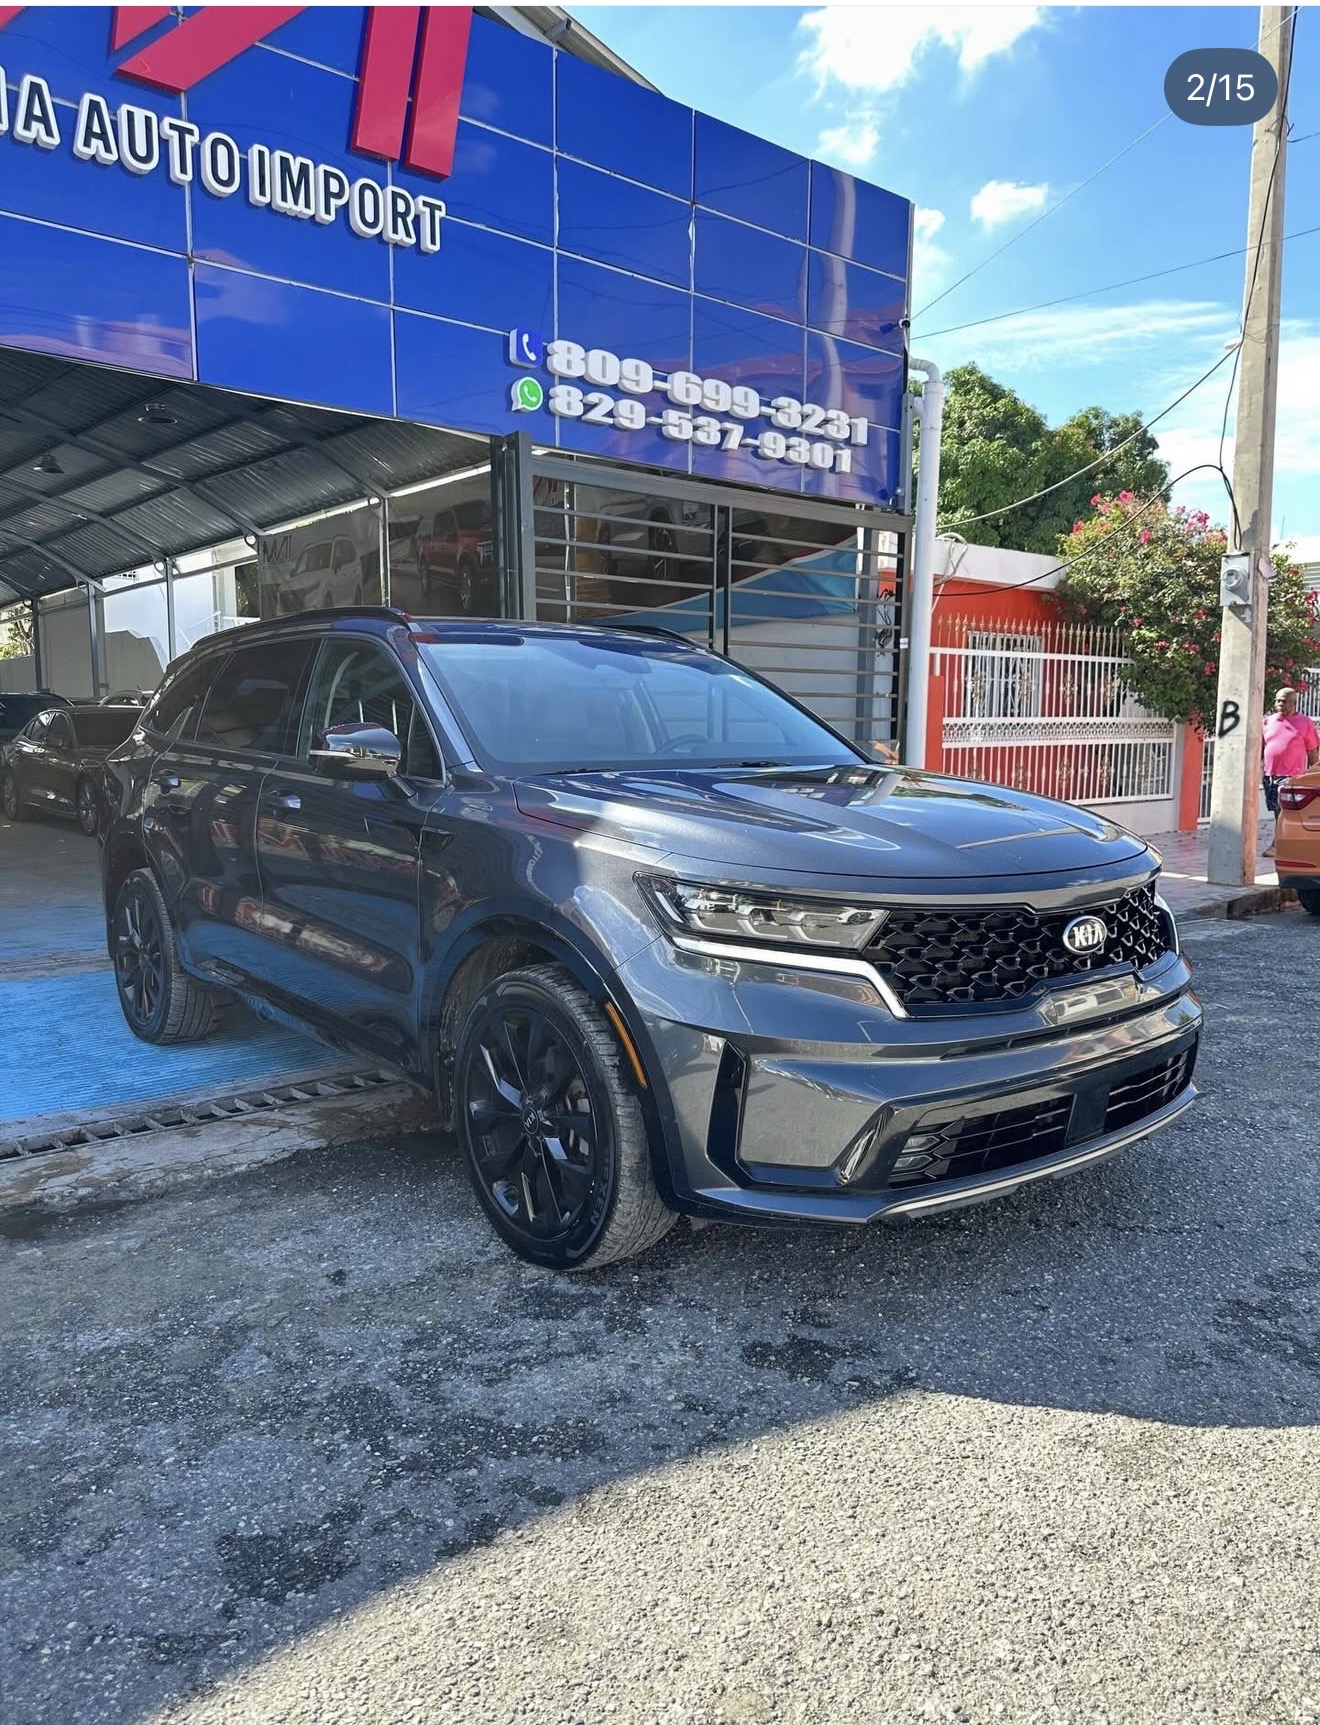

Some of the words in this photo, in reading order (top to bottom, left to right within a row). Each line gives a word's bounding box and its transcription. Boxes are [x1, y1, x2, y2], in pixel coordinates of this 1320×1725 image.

[73, 92, 241, 197] AUTO
[248, 143, 447, 254] IMPORT
[547, 339, 869, 446] 809-699-3231
[549, 384, 853, 474] 829-537-9301
[1218, 700, 1240, 739] B
[1072, 922, 1104, 948] KIA
